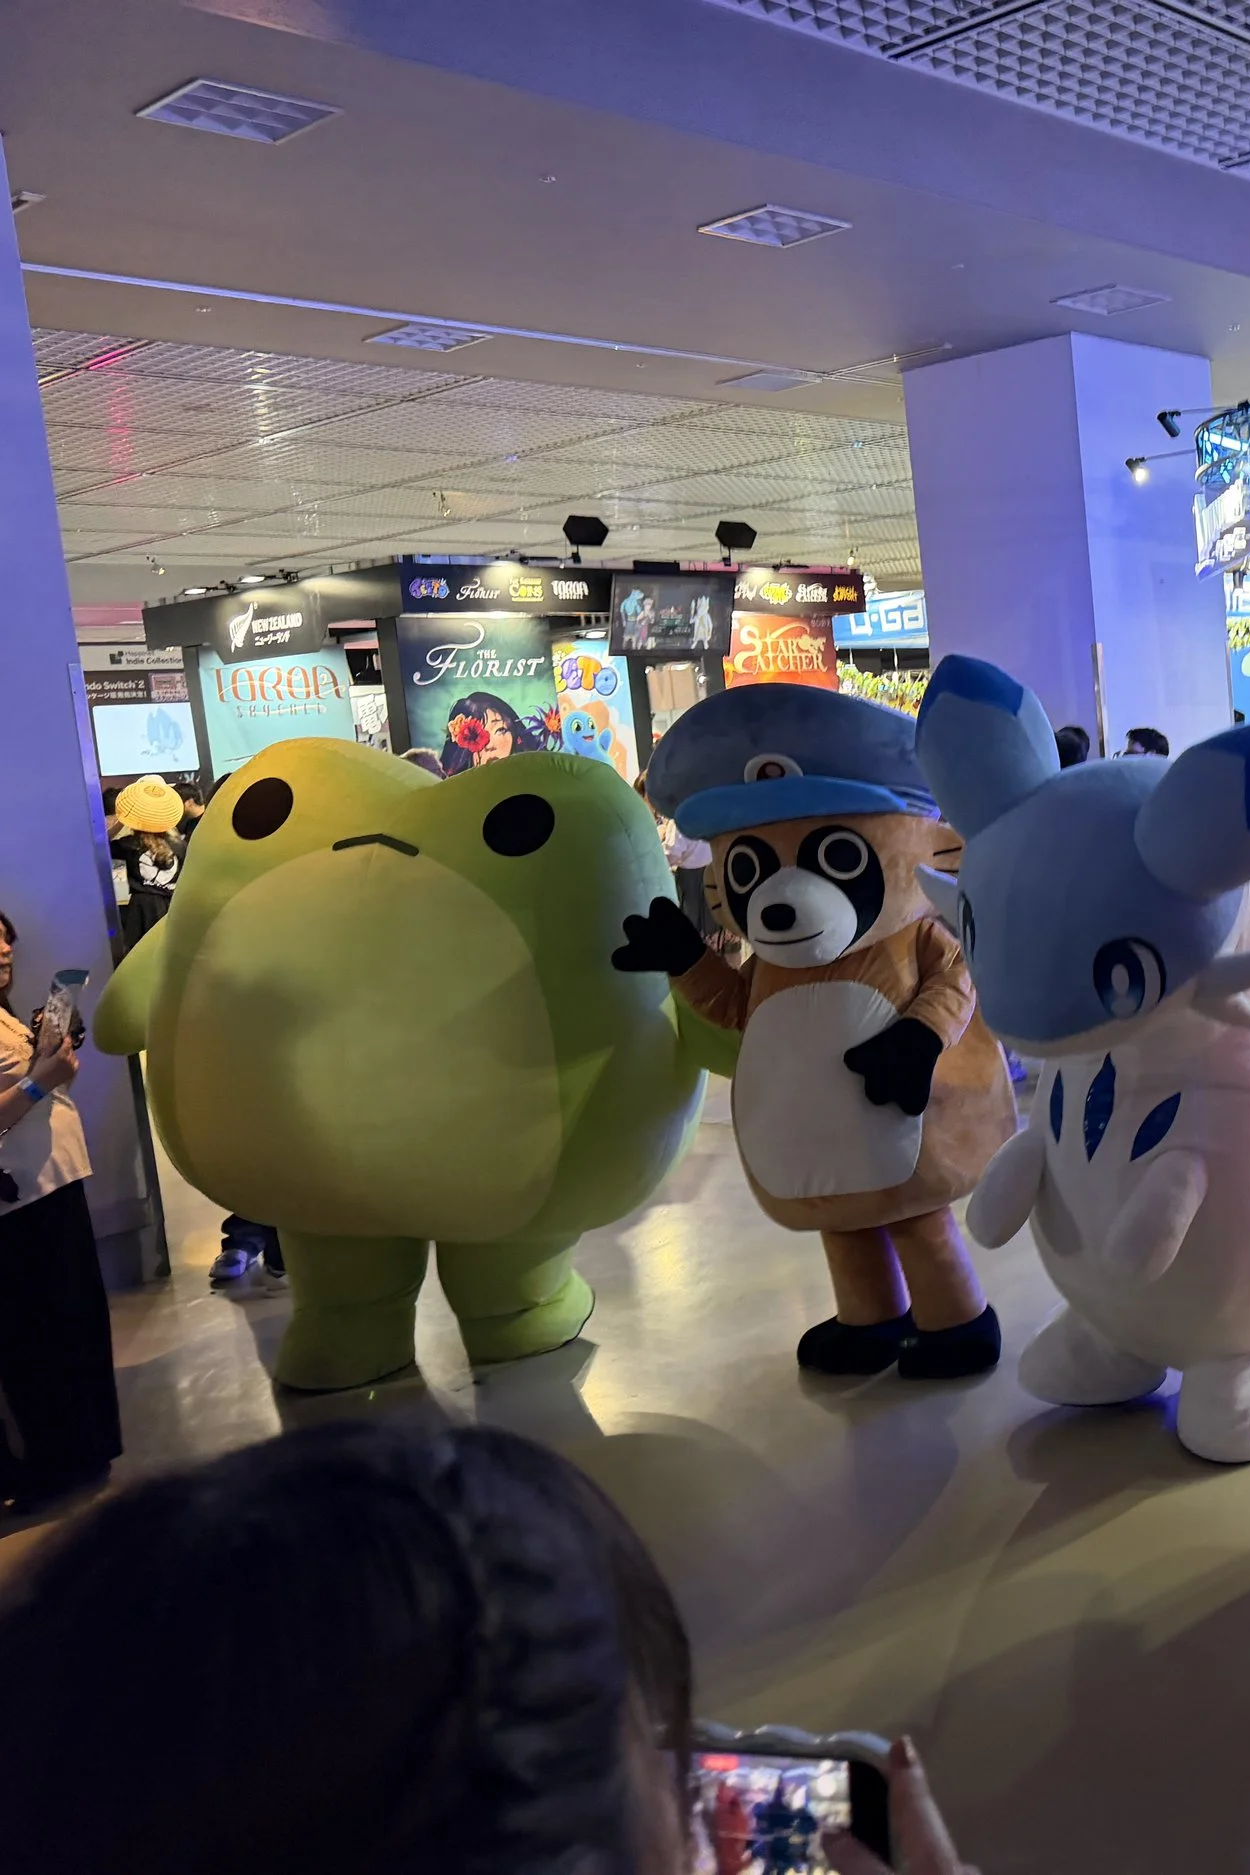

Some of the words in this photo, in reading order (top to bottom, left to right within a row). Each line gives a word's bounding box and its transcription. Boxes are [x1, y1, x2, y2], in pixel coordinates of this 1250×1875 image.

[413, 620, 545, 686] FLORIST
[476, 649, 497, 660] THE
[125, 657, 145, 665] Indie
[733, 651, 828, 675] CATCHER
[103, 680, 136, 690] Switch
[137, 680, 145, 689] 2
